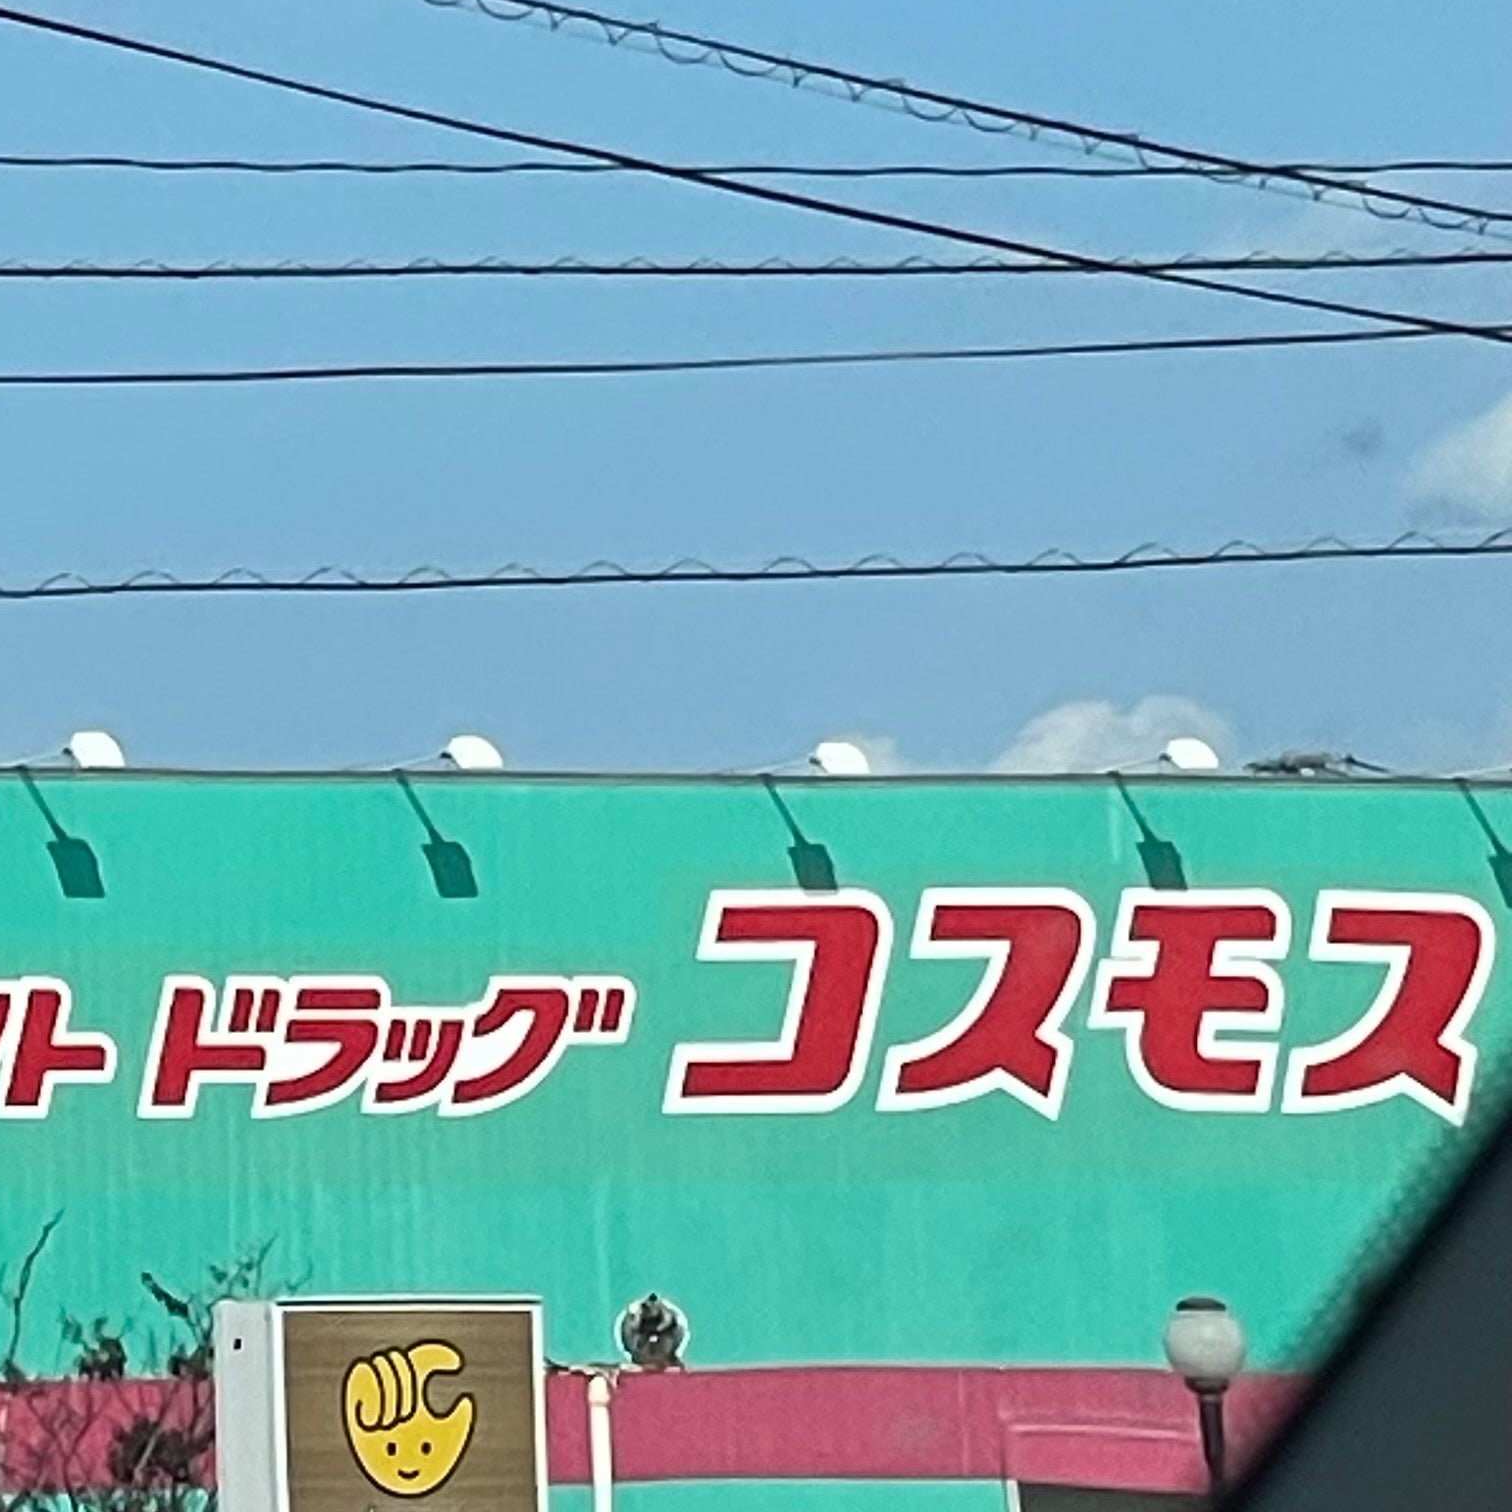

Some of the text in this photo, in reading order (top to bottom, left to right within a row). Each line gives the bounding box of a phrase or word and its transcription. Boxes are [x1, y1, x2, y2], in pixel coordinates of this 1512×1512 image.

[137, 974, 635, 1120] ドラッグ
[663, 888, 1494, 1126] コスモス
